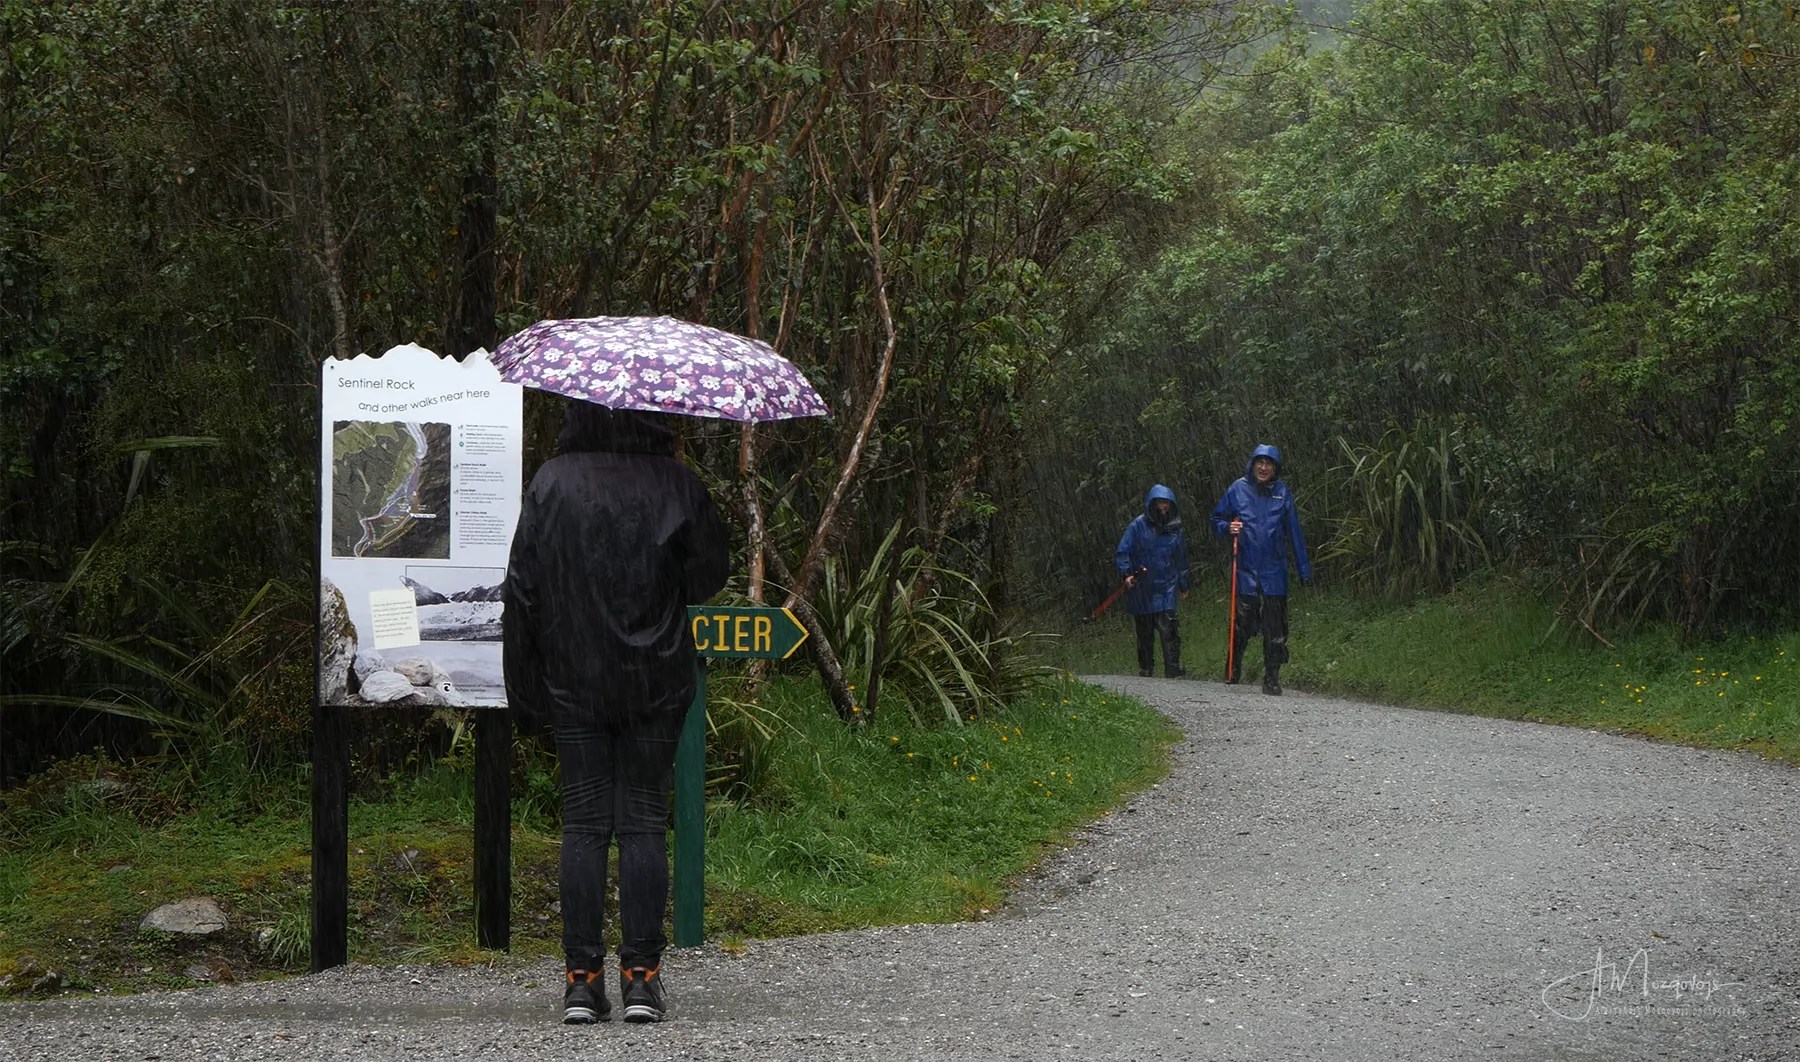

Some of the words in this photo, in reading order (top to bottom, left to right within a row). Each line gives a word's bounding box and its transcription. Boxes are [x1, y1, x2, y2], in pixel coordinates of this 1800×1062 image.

[338, 377, 383, 389] Sentinel
[386, 379, 416, 390] Rock
[358, 401, 379, 412] and
[381, 403, 408, 413] other
[409, 396, 438, 409] walks
[439, 390, 464, 402] near
[466, 389, 491, 399] here
[692, 614, 772, 652] CIER
